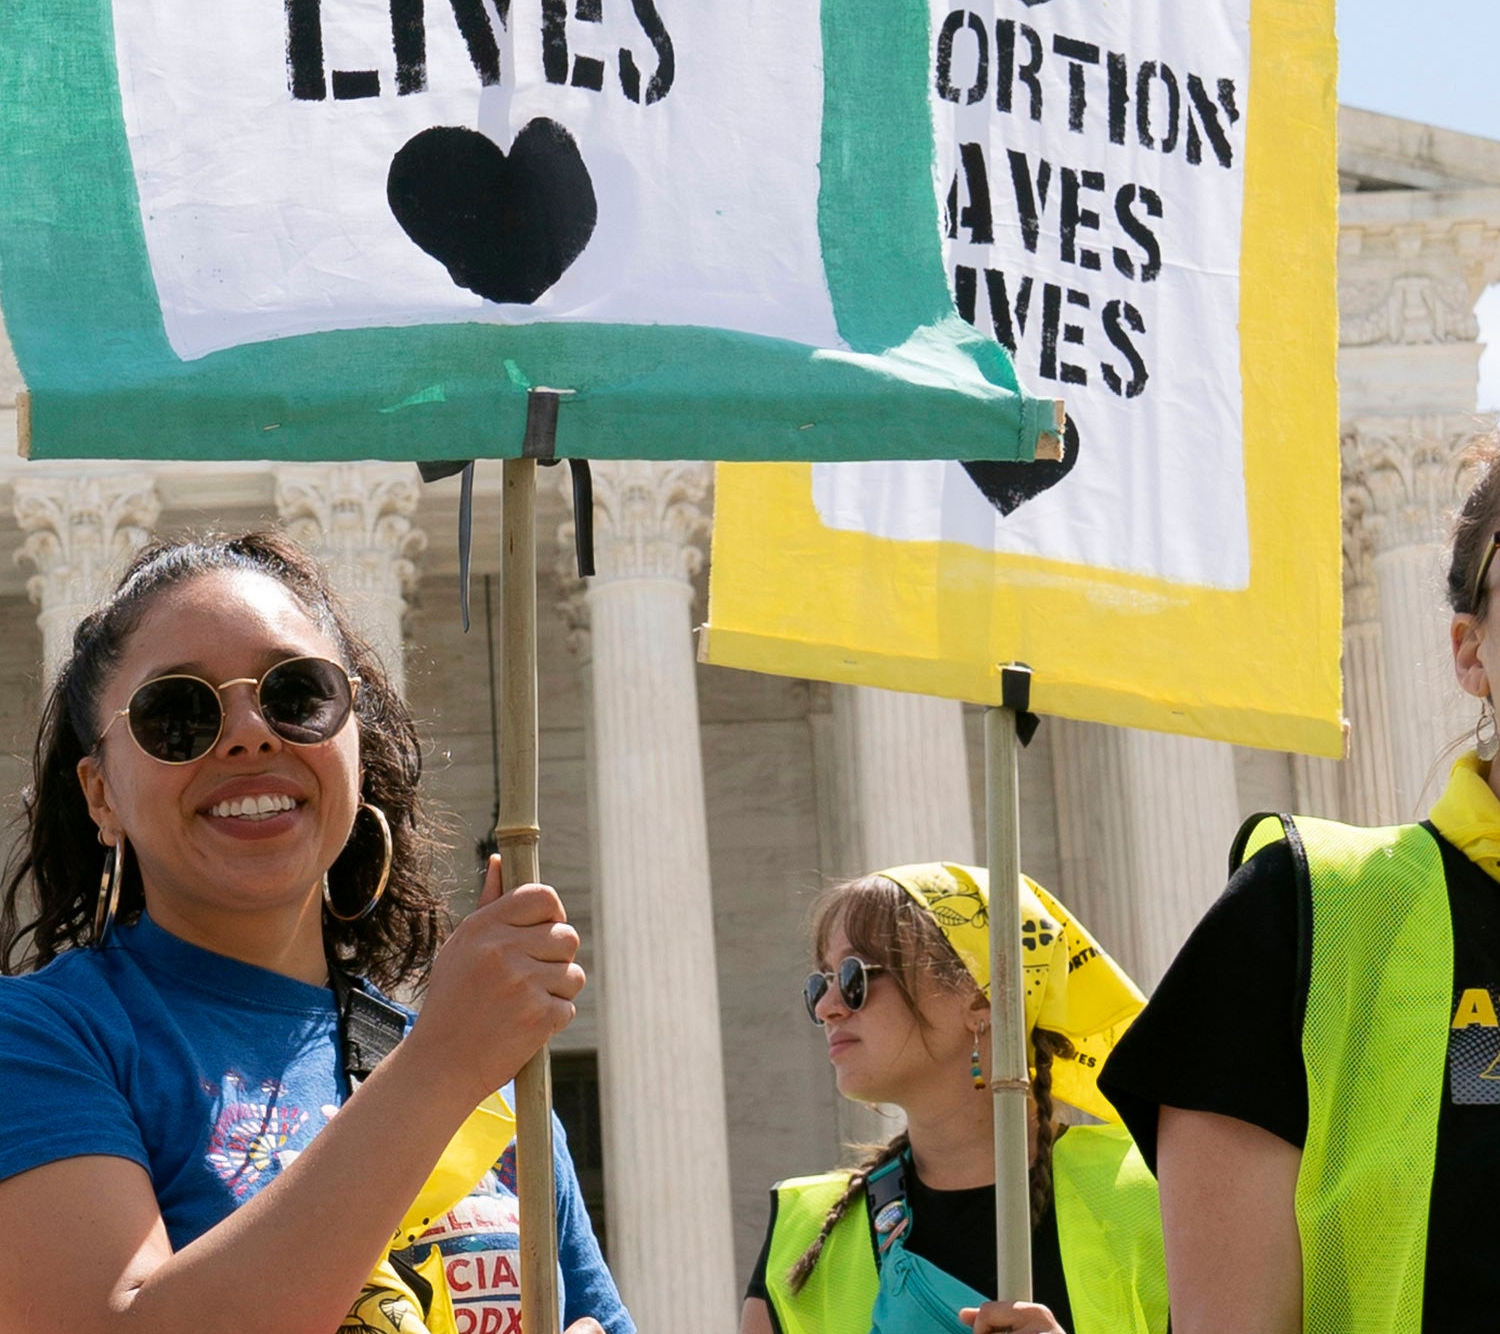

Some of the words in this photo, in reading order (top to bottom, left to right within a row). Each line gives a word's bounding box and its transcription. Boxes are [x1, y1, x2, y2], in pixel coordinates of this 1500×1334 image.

[935, 7, 1240, 169] ORTION
[946, 142, 1164, 282] AVES
[955, 265, 1149, 399] IVES
[446, 1256, 519, 1293] CIA
